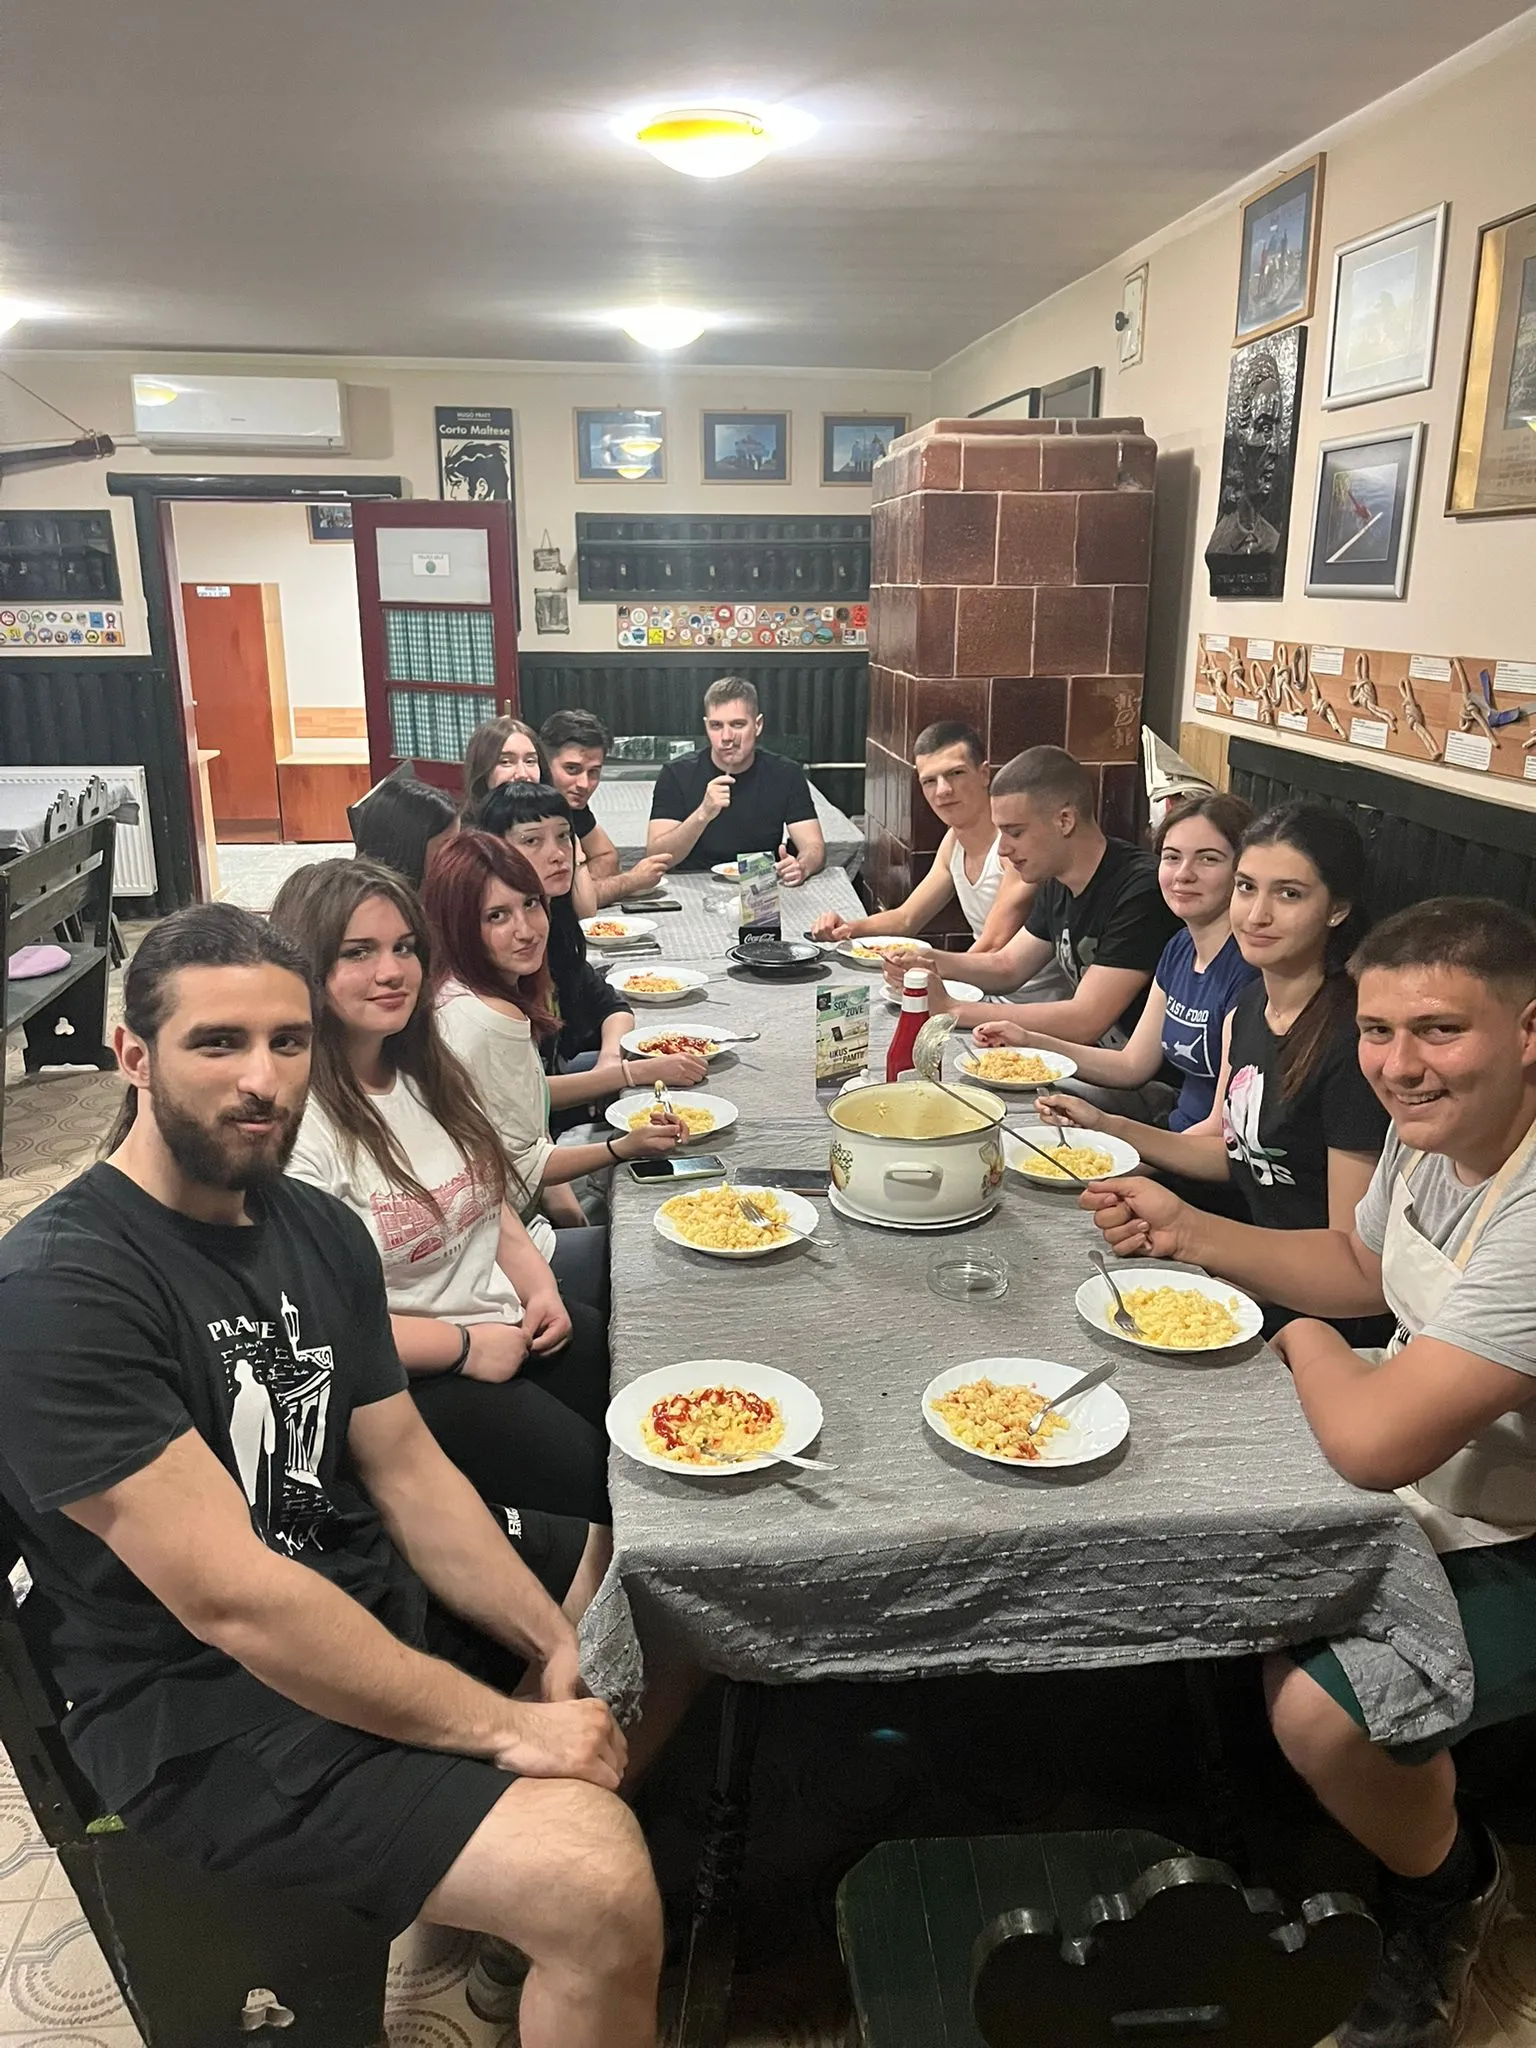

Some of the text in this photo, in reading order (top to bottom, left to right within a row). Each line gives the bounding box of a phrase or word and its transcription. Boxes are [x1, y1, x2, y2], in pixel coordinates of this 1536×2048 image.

[439, 424, 511, 436] Corto Maltese
[833, 1000, 848, 1011] SOK
[1166, 995, 1209, 1023] FAST FOOD
